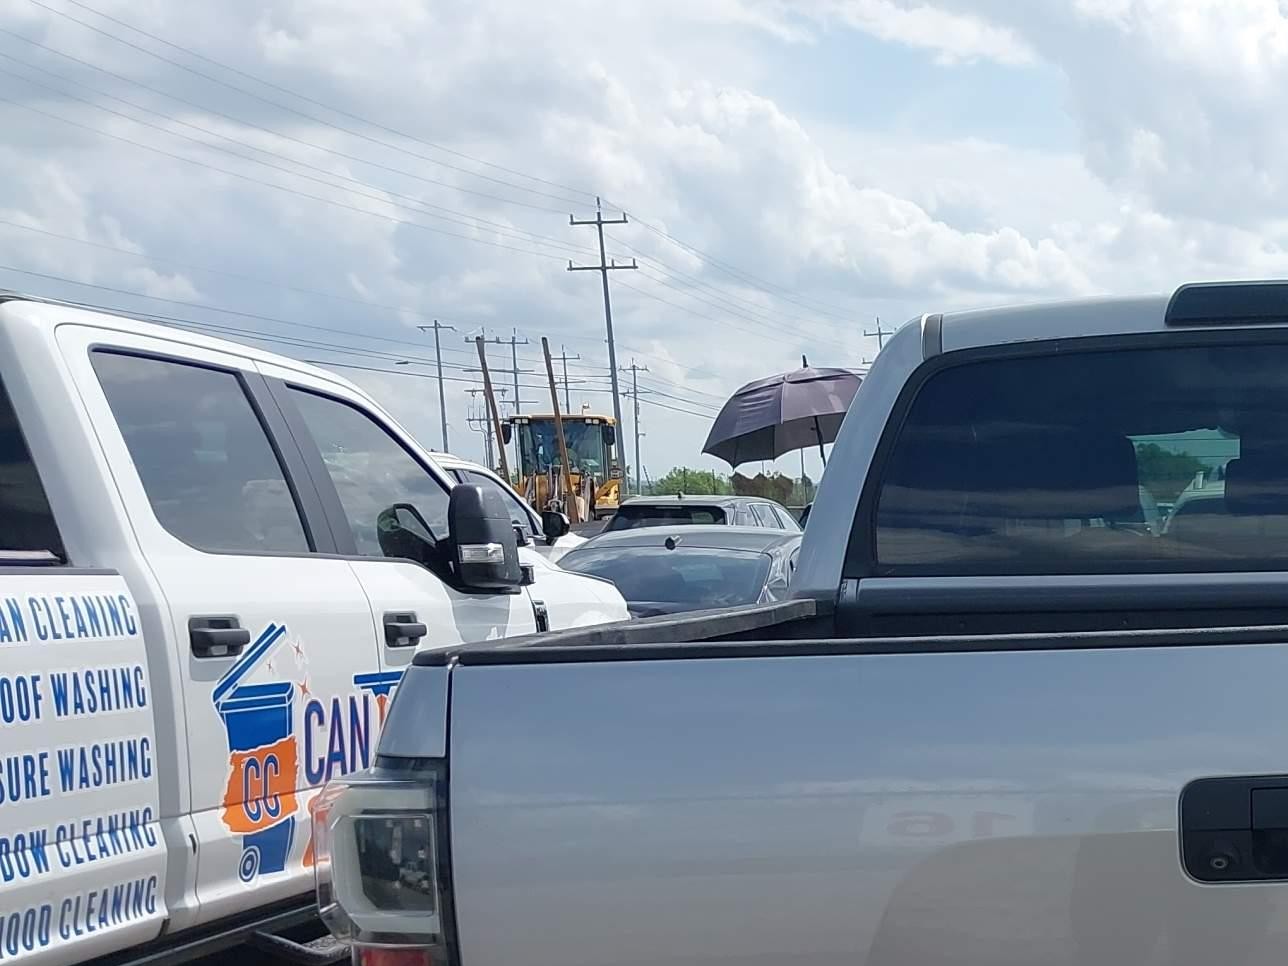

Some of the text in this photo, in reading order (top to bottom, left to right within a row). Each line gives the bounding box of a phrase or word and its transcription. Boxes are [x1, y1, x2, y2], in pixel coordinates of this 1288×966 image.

[28, 594, 137, 641] CLEANING
[0, 665, 147, 724] OOF WASHING
[57, 736, 152, 793] WASHING
[243, 754, 280, 822] CC
[0, 806, 158, 882] DOW CLEANING
[59, 875, 157, 940] CLEANING
